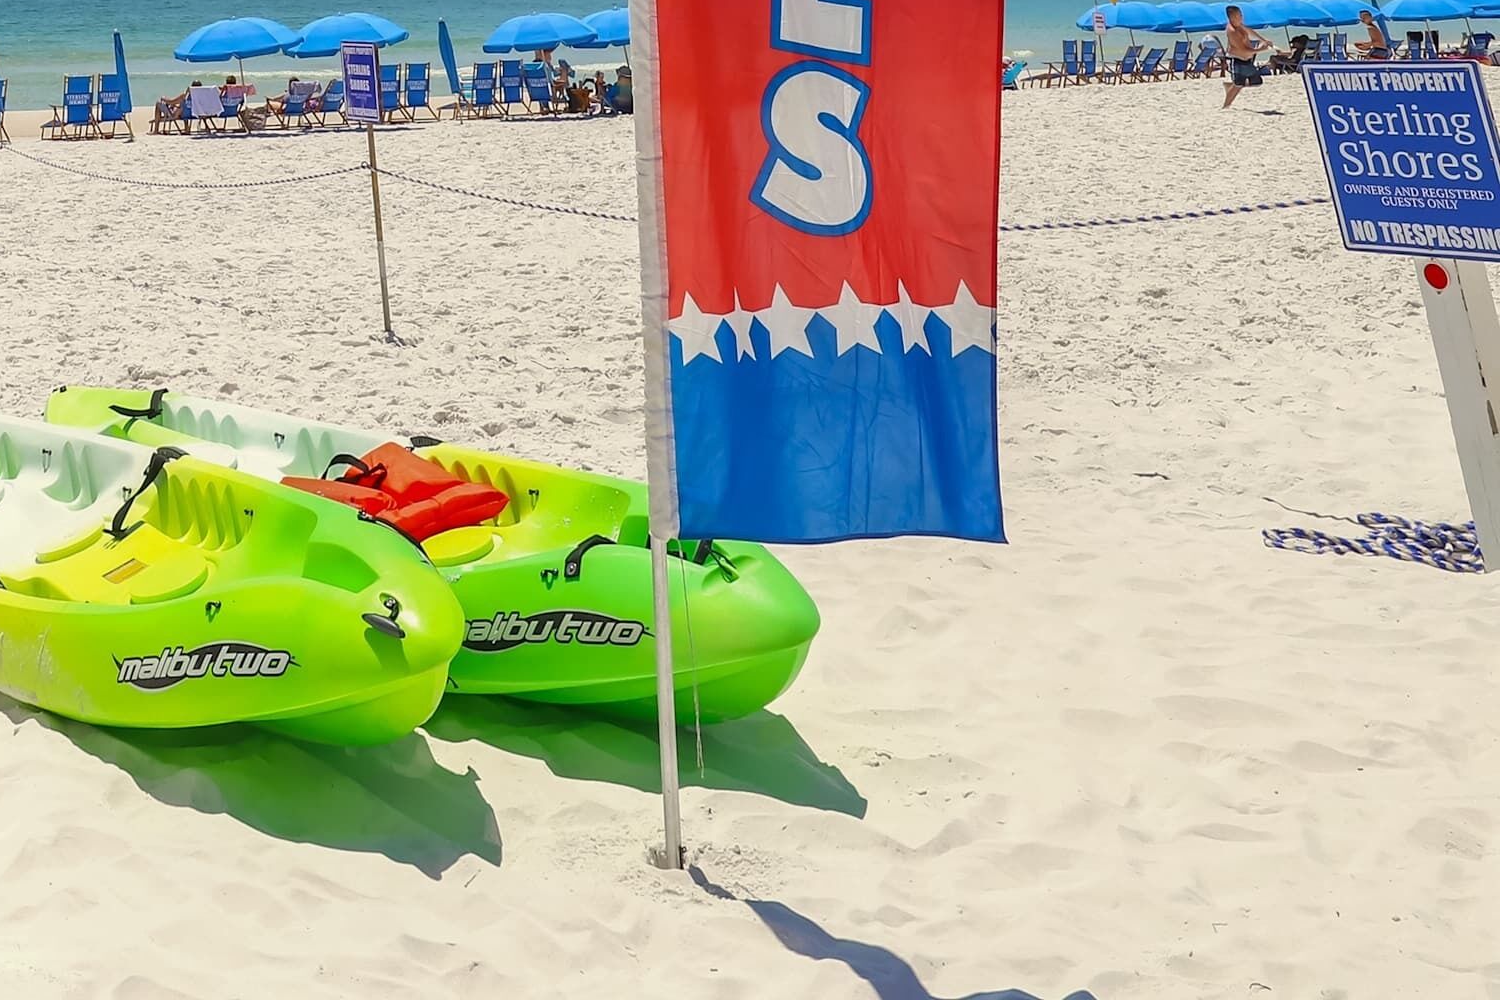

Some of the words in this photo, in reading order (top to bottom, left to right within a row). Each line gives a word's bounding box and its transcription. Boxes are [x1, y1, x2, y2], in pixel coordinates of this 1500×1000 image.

[1314, 72, 1379, 91] PRIVATE
[1380, 72, 1466, 92] PROPERTY
[1328, 104, 1476, 145] Sterling
[1339, 141, 1483, 181] Shores
[1344, 184, 1392, 196] OWNERS
[1394, 186, 1419, 197] AND
[1422, 188, 1494, 201] REGISTERED
[1381, 196, 1425, 208] GUESTS
[1427, 199, 1458, 210] ONLY
[1350, 219, 1378, 242] NO
[464, 613, 554, 643] alibu
[555, 613, 643, 645] two
[117, 647, 212, 682] malibu
[212, 645, 291, 677] two
